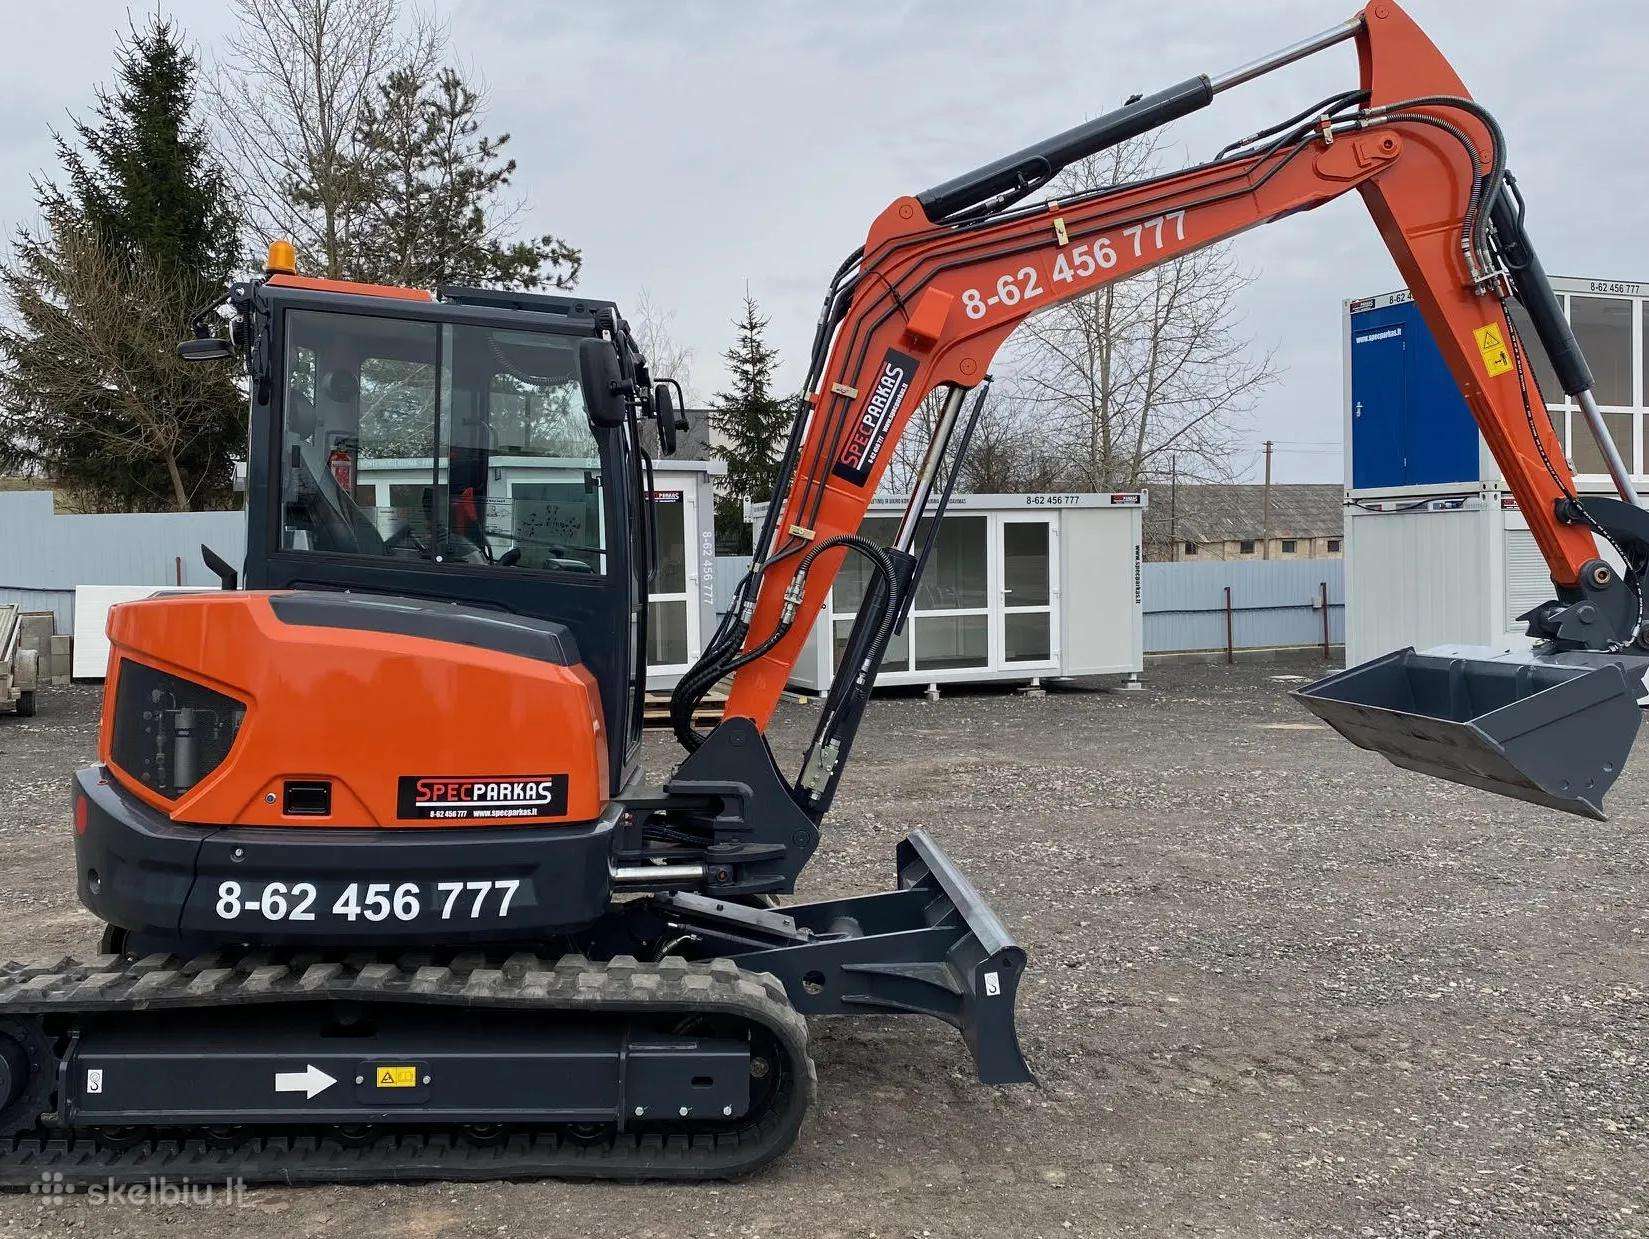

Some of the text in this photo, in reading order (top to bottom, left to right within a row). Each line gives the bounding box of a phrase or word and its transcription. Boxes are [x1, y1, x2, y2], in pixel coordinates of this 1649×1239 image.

[961, 209, 1186, 320] 8-62 456 777
[1389, 293, 1405, 304] 8-62
[1590, 281, 1640, 294] 8-62 456 777
[840, 362, 904, 471] SPECPARKAS
[1026, 495, 1080, 505] 8-62 456 777
[702, 531, 714, 605] 8-62 456 777
[415, 777, 552, 807] SPECPARKAS
[429, 808, 538, 818] 8-62 456 777 www.specparkas.lt
[215, 879, 520, 922] 8-62 456 777
